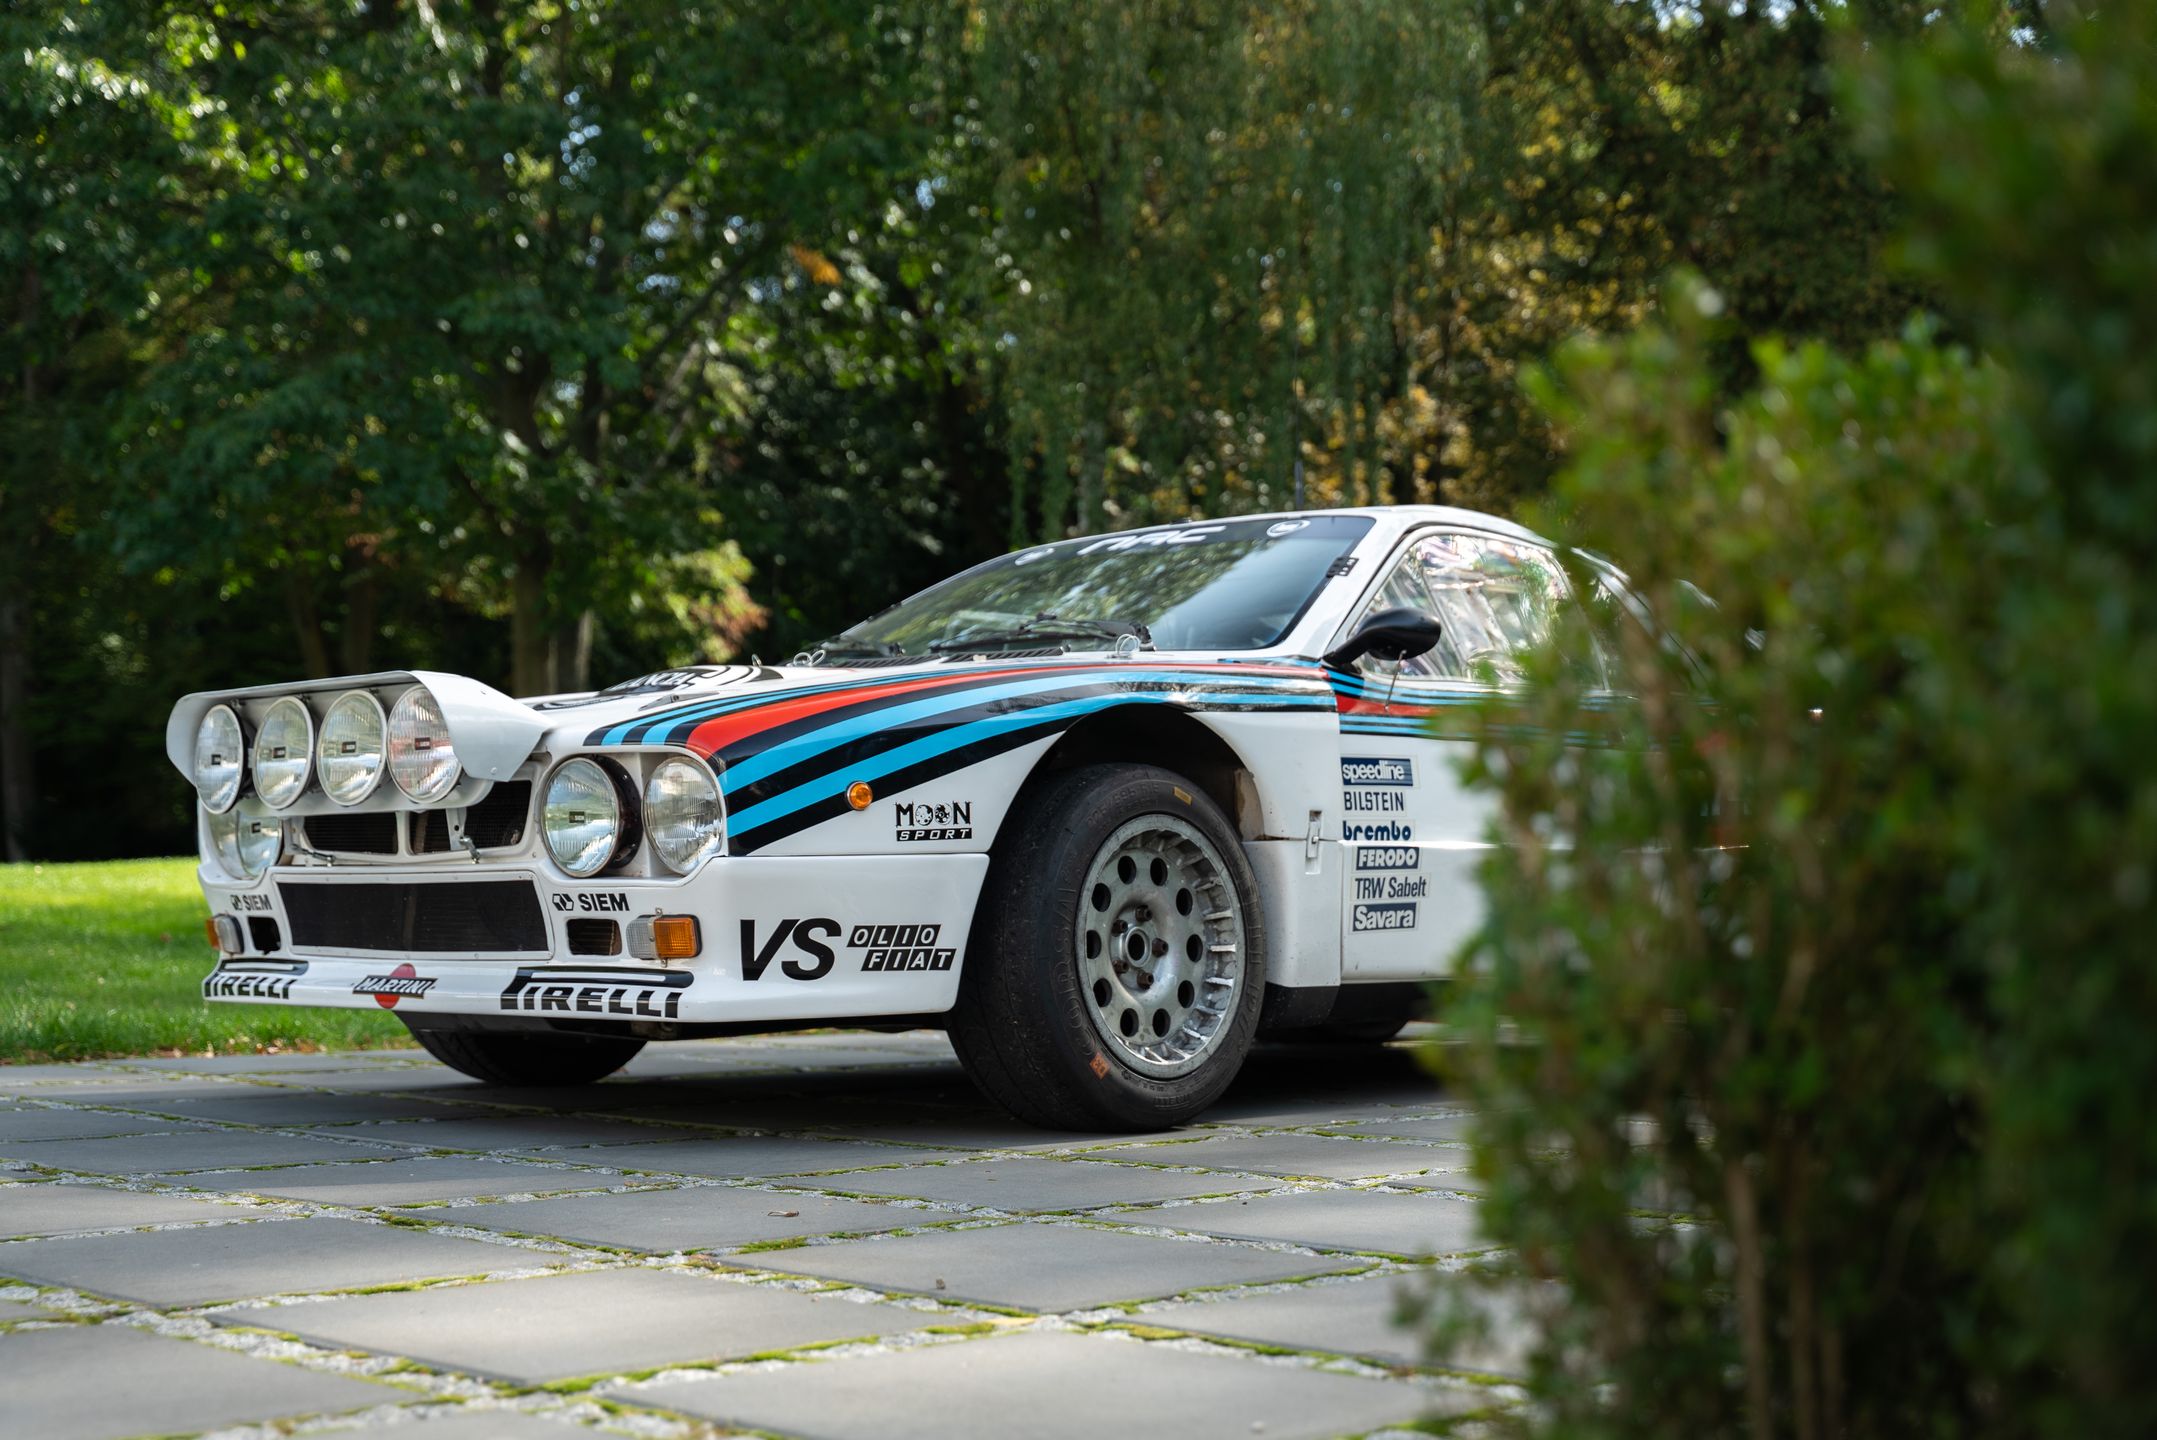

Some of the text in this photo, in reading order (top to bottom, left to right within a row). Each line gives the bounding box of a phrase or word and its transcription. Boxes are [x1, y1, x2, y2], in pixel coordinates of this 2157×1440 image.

[1342, 760, 1406, 783] speedline
[1343, 791, 1405, 811] BILSTEIN
[894, 801, 972, 828] MOON
[899, 828, 971, 841] SPORT
[1342, 820, 1412, 841] brembo
[1357, 848, 1417, 868] FERODO
[1354, 875, 1428, 900] TRW Sabelt
[243, 894, 273, 911] SIEM
[578, 892, 630, 912] SIEM
[1354, 905, 1415, 930] Savara
[851, 926, 938, 946] OLIO
[740, 917, 842, 981] VS
[865, 950, 953, 970] FIAT
[204, 958, 309, 1000] PIRELLI
[354, 977, 434, 995] MARTINI
[501, 965, 694, 1018] PIRELLI
